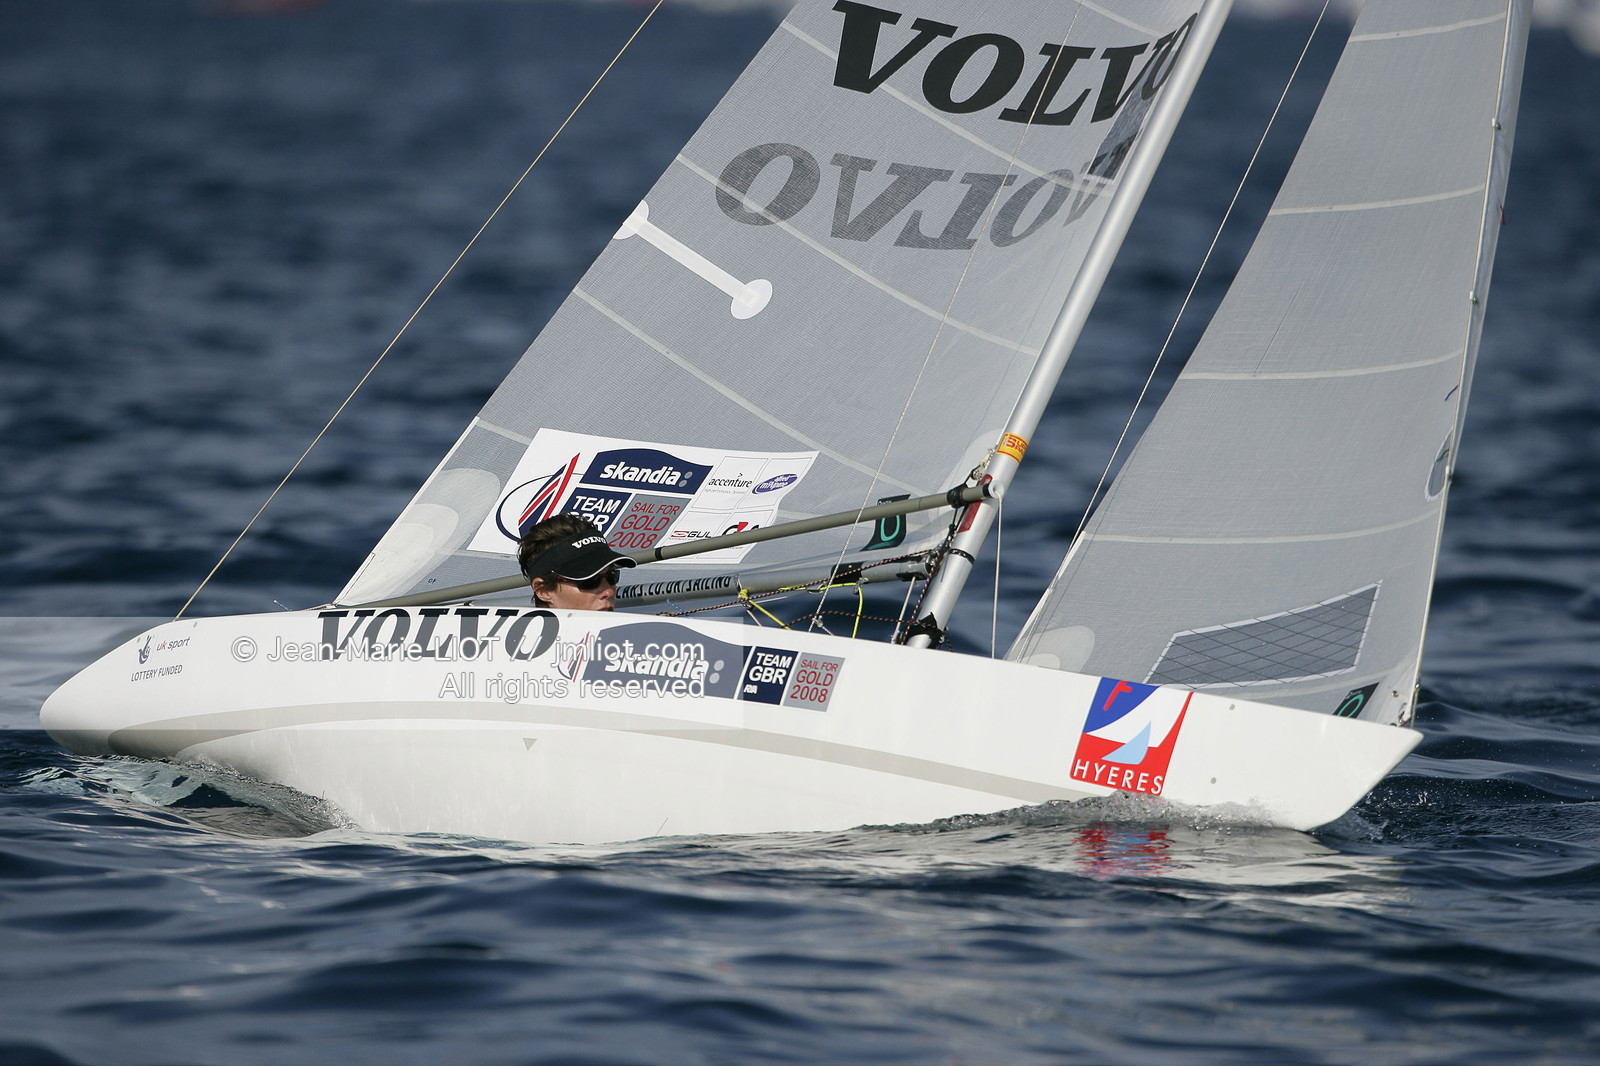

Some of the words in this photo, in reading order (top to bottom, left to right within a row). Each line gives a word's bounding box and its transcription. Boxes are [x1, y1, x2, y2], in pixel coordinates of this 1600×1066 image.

[833, 0, 1197, 126] VOLVO
[600, 461, 681, 485] skandia
[708, 474, 752, 488] accenture
[572, 495, 621, 514] TEAM
[631, 502, 654, 514] SAIL
[656, 504, 680, 515] FOR
[621, 514, 670, 532] GOLD
[571, 536, 606, 549] VOLVO
[608, 532, 658, 549] 2008
[167, 636, 191, 651] sport
[318, 608, 560, 661] VOLVO
[756, 652, 792, 668] TEAM
[800, 659, 819, 670] SAIL
[820, 661, 839, 672] FOR
[130, 668, 158, 682] LOTTERY
[158, 664, 183, 677] FUNDED
[749, 666, 787, 685] GBR
[796, 669, 834, 687] GOLD
[790, 684, 828, 703] 2008
[1073, 759, 1163, 794] HYERES
